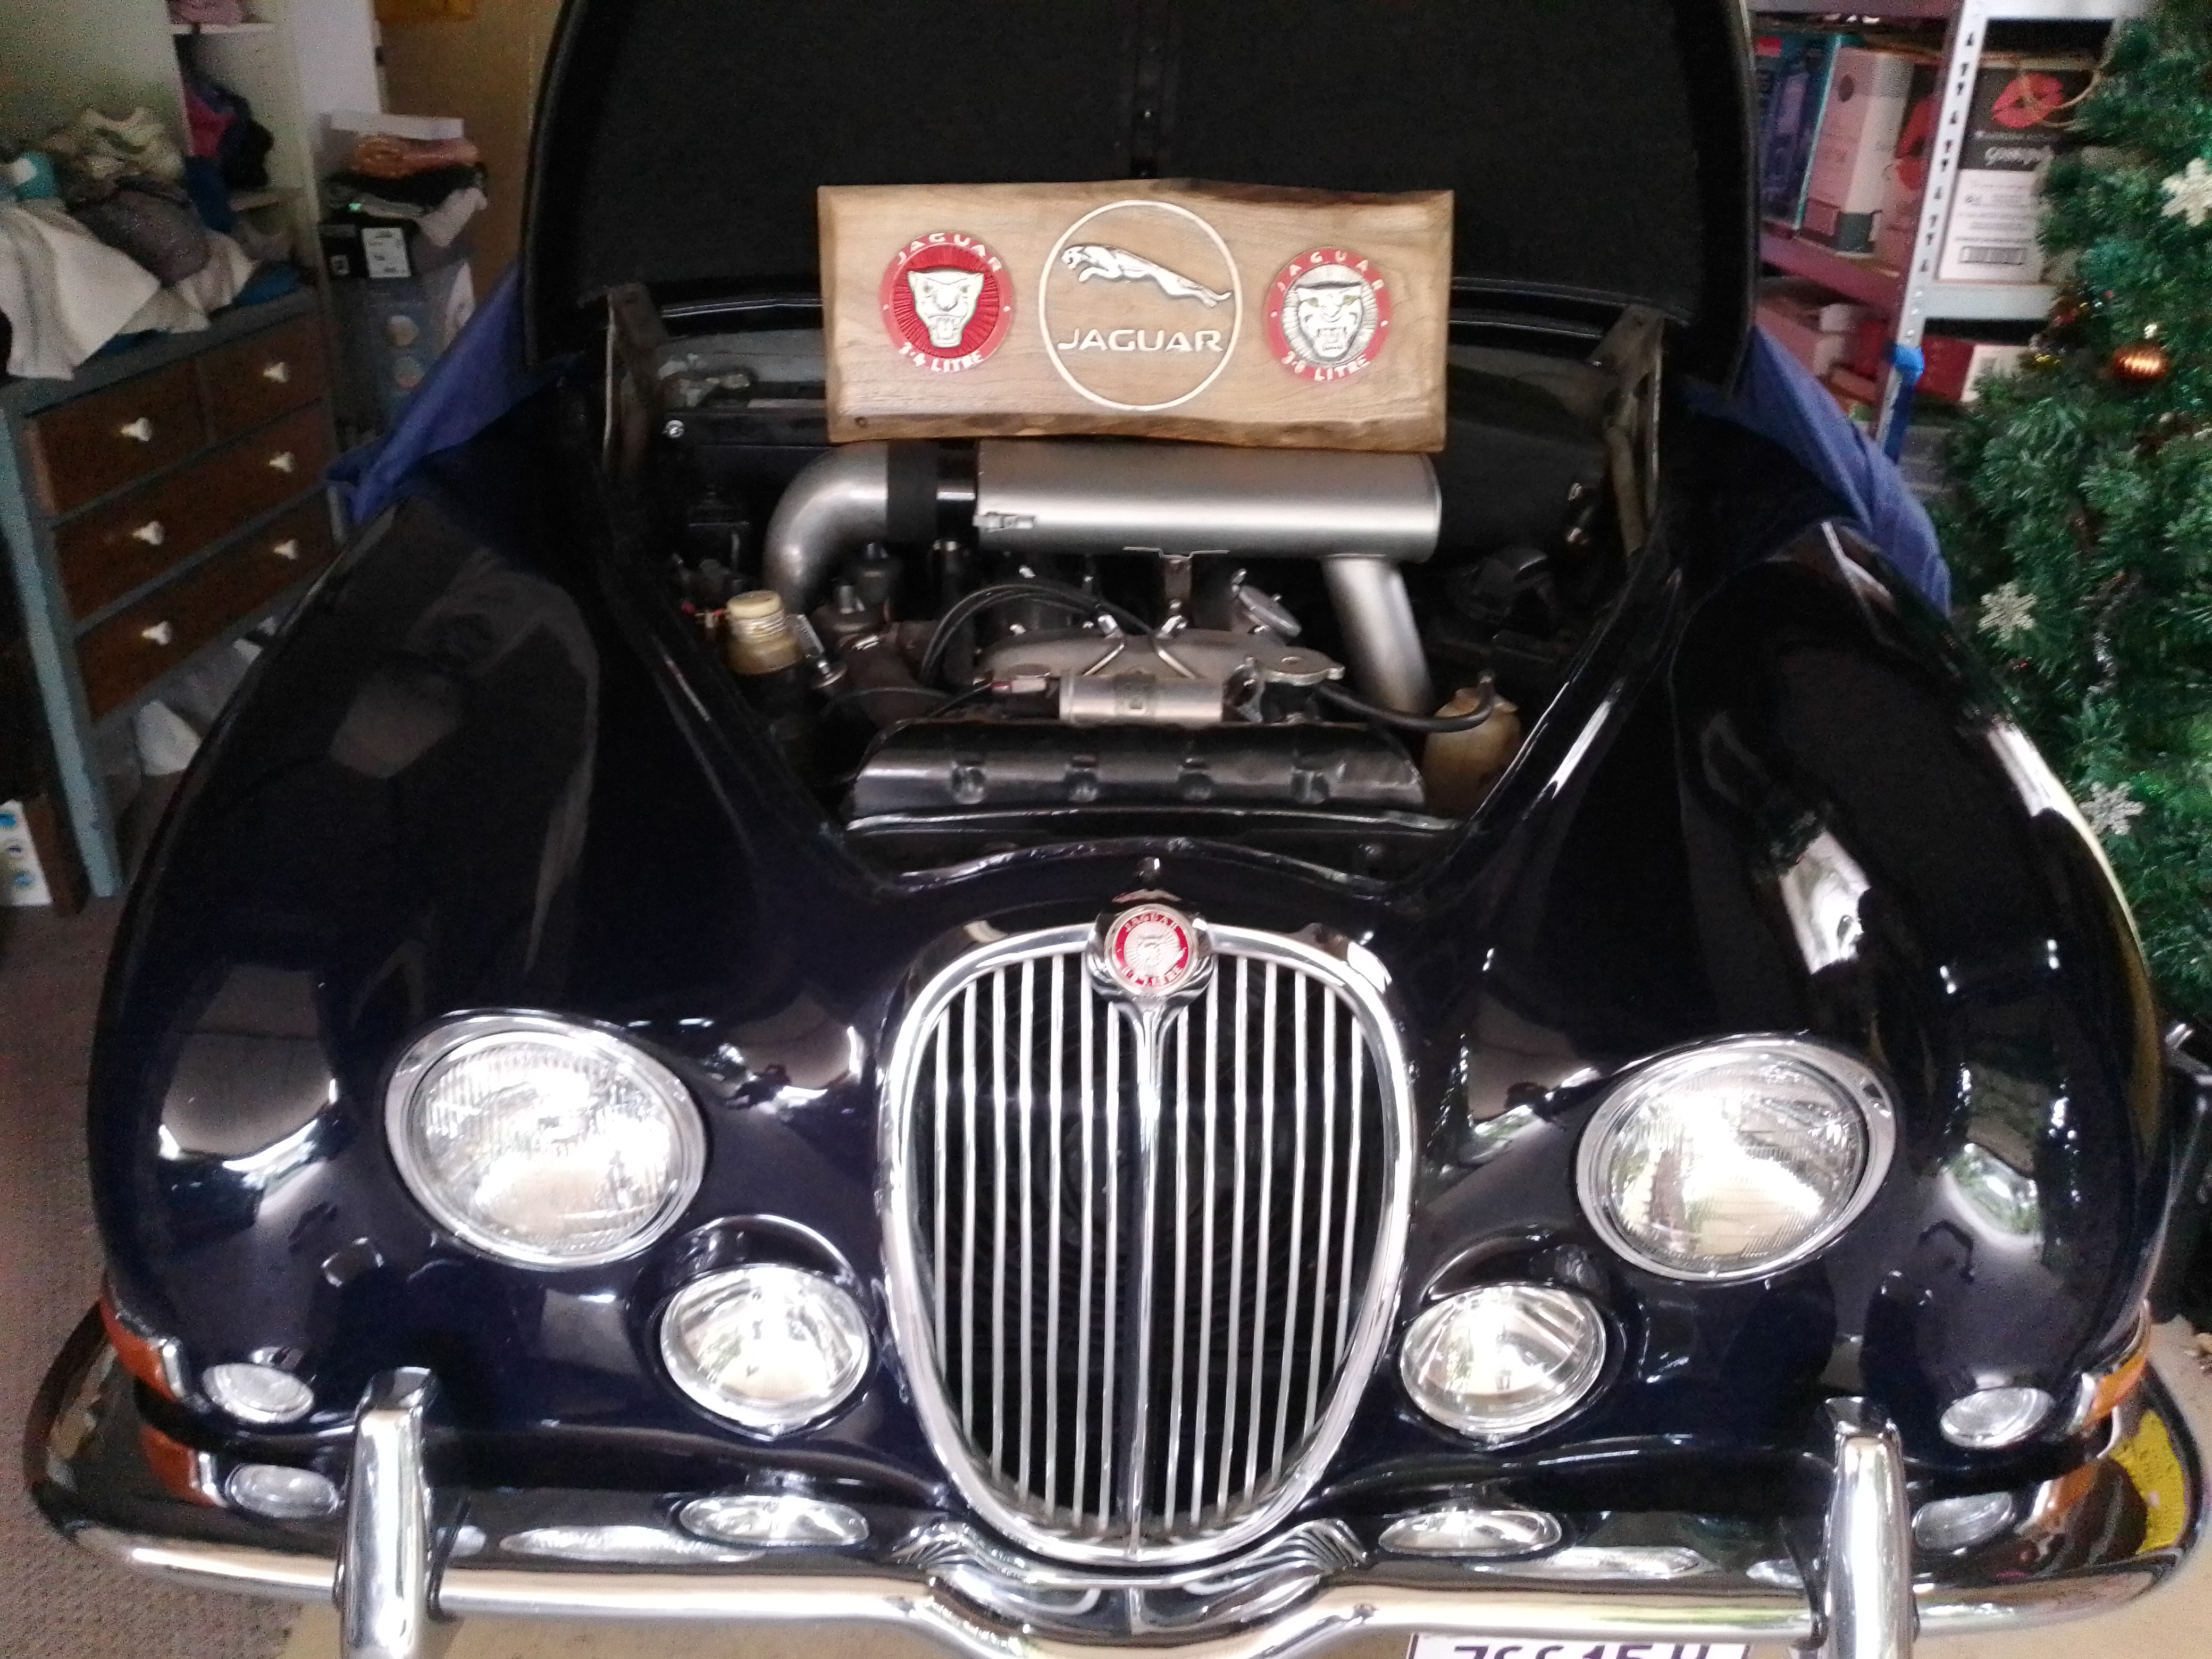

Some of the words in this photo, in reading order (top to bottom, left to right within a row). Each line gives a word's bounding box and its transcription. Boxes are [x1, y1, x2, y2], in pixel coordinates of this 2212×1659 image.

[898, 232, 1002, 272] JAGUAR
[1277, 250, 1385, 291] JAGUAR
[1057, 328, 1224, 353] JAGUAR
[931, 350, 984, 372] LITRE
[1314, 354, 1371, 382] LITRE
